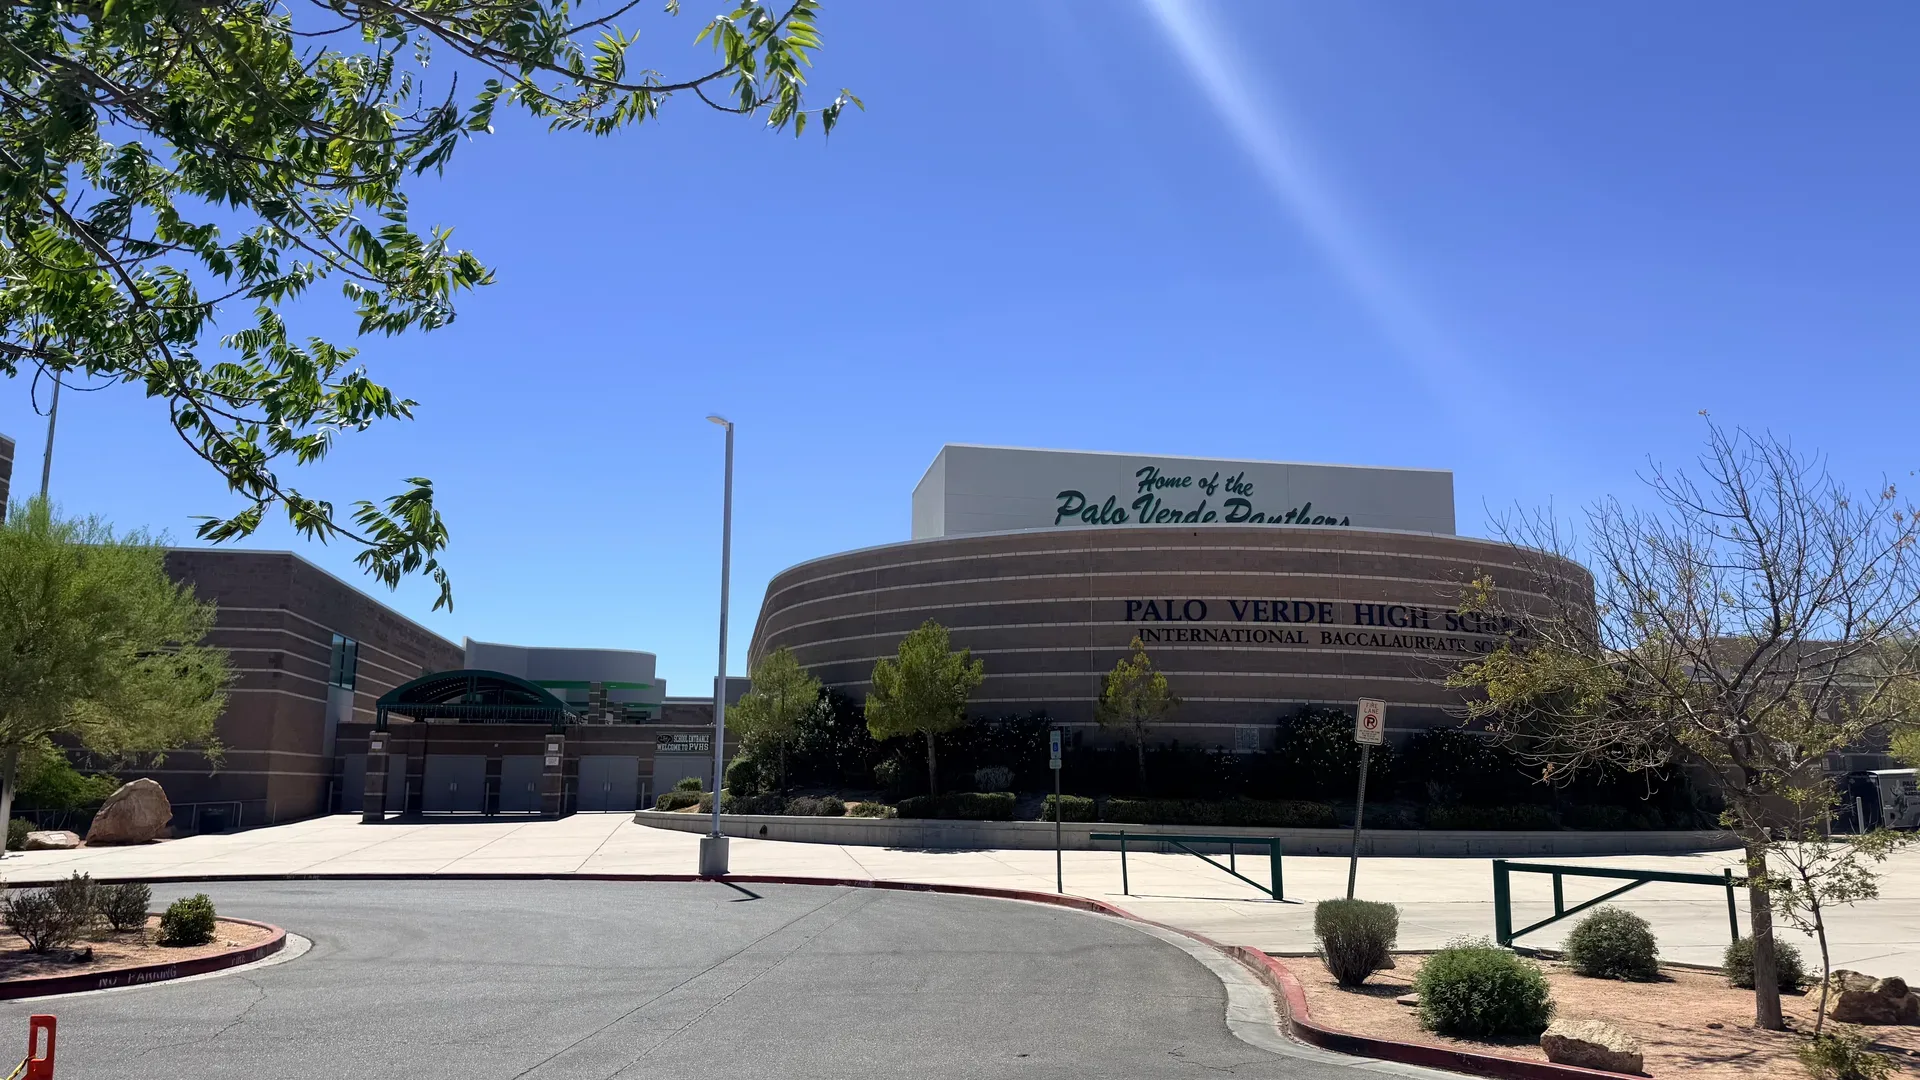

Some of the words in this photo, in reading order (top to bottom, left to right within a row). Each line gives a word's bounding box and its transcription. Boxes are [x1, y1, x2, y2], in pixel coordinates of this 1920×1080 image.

[1135, 466, 1192, 493] Home
[1198, 472, 1219, 497] of
[1224, 471, 1254, 497] the
[1054, 490, 1130, 525] Palo
[1131, 493, 1219, 524] Verde
[1223, 498, 1350, 526] Panthers
[1124, 600, 1207, 621] PALO
[1227, 600, 1334, 623] VERDE
[1353, 603, 1431, 629] HIGH
[1138, 628, 1309, 644] INTERNATIONAL
[1320, 631, 1466, 651] BACCALAUREATE
[689, 743, 709, 751] PVHS
